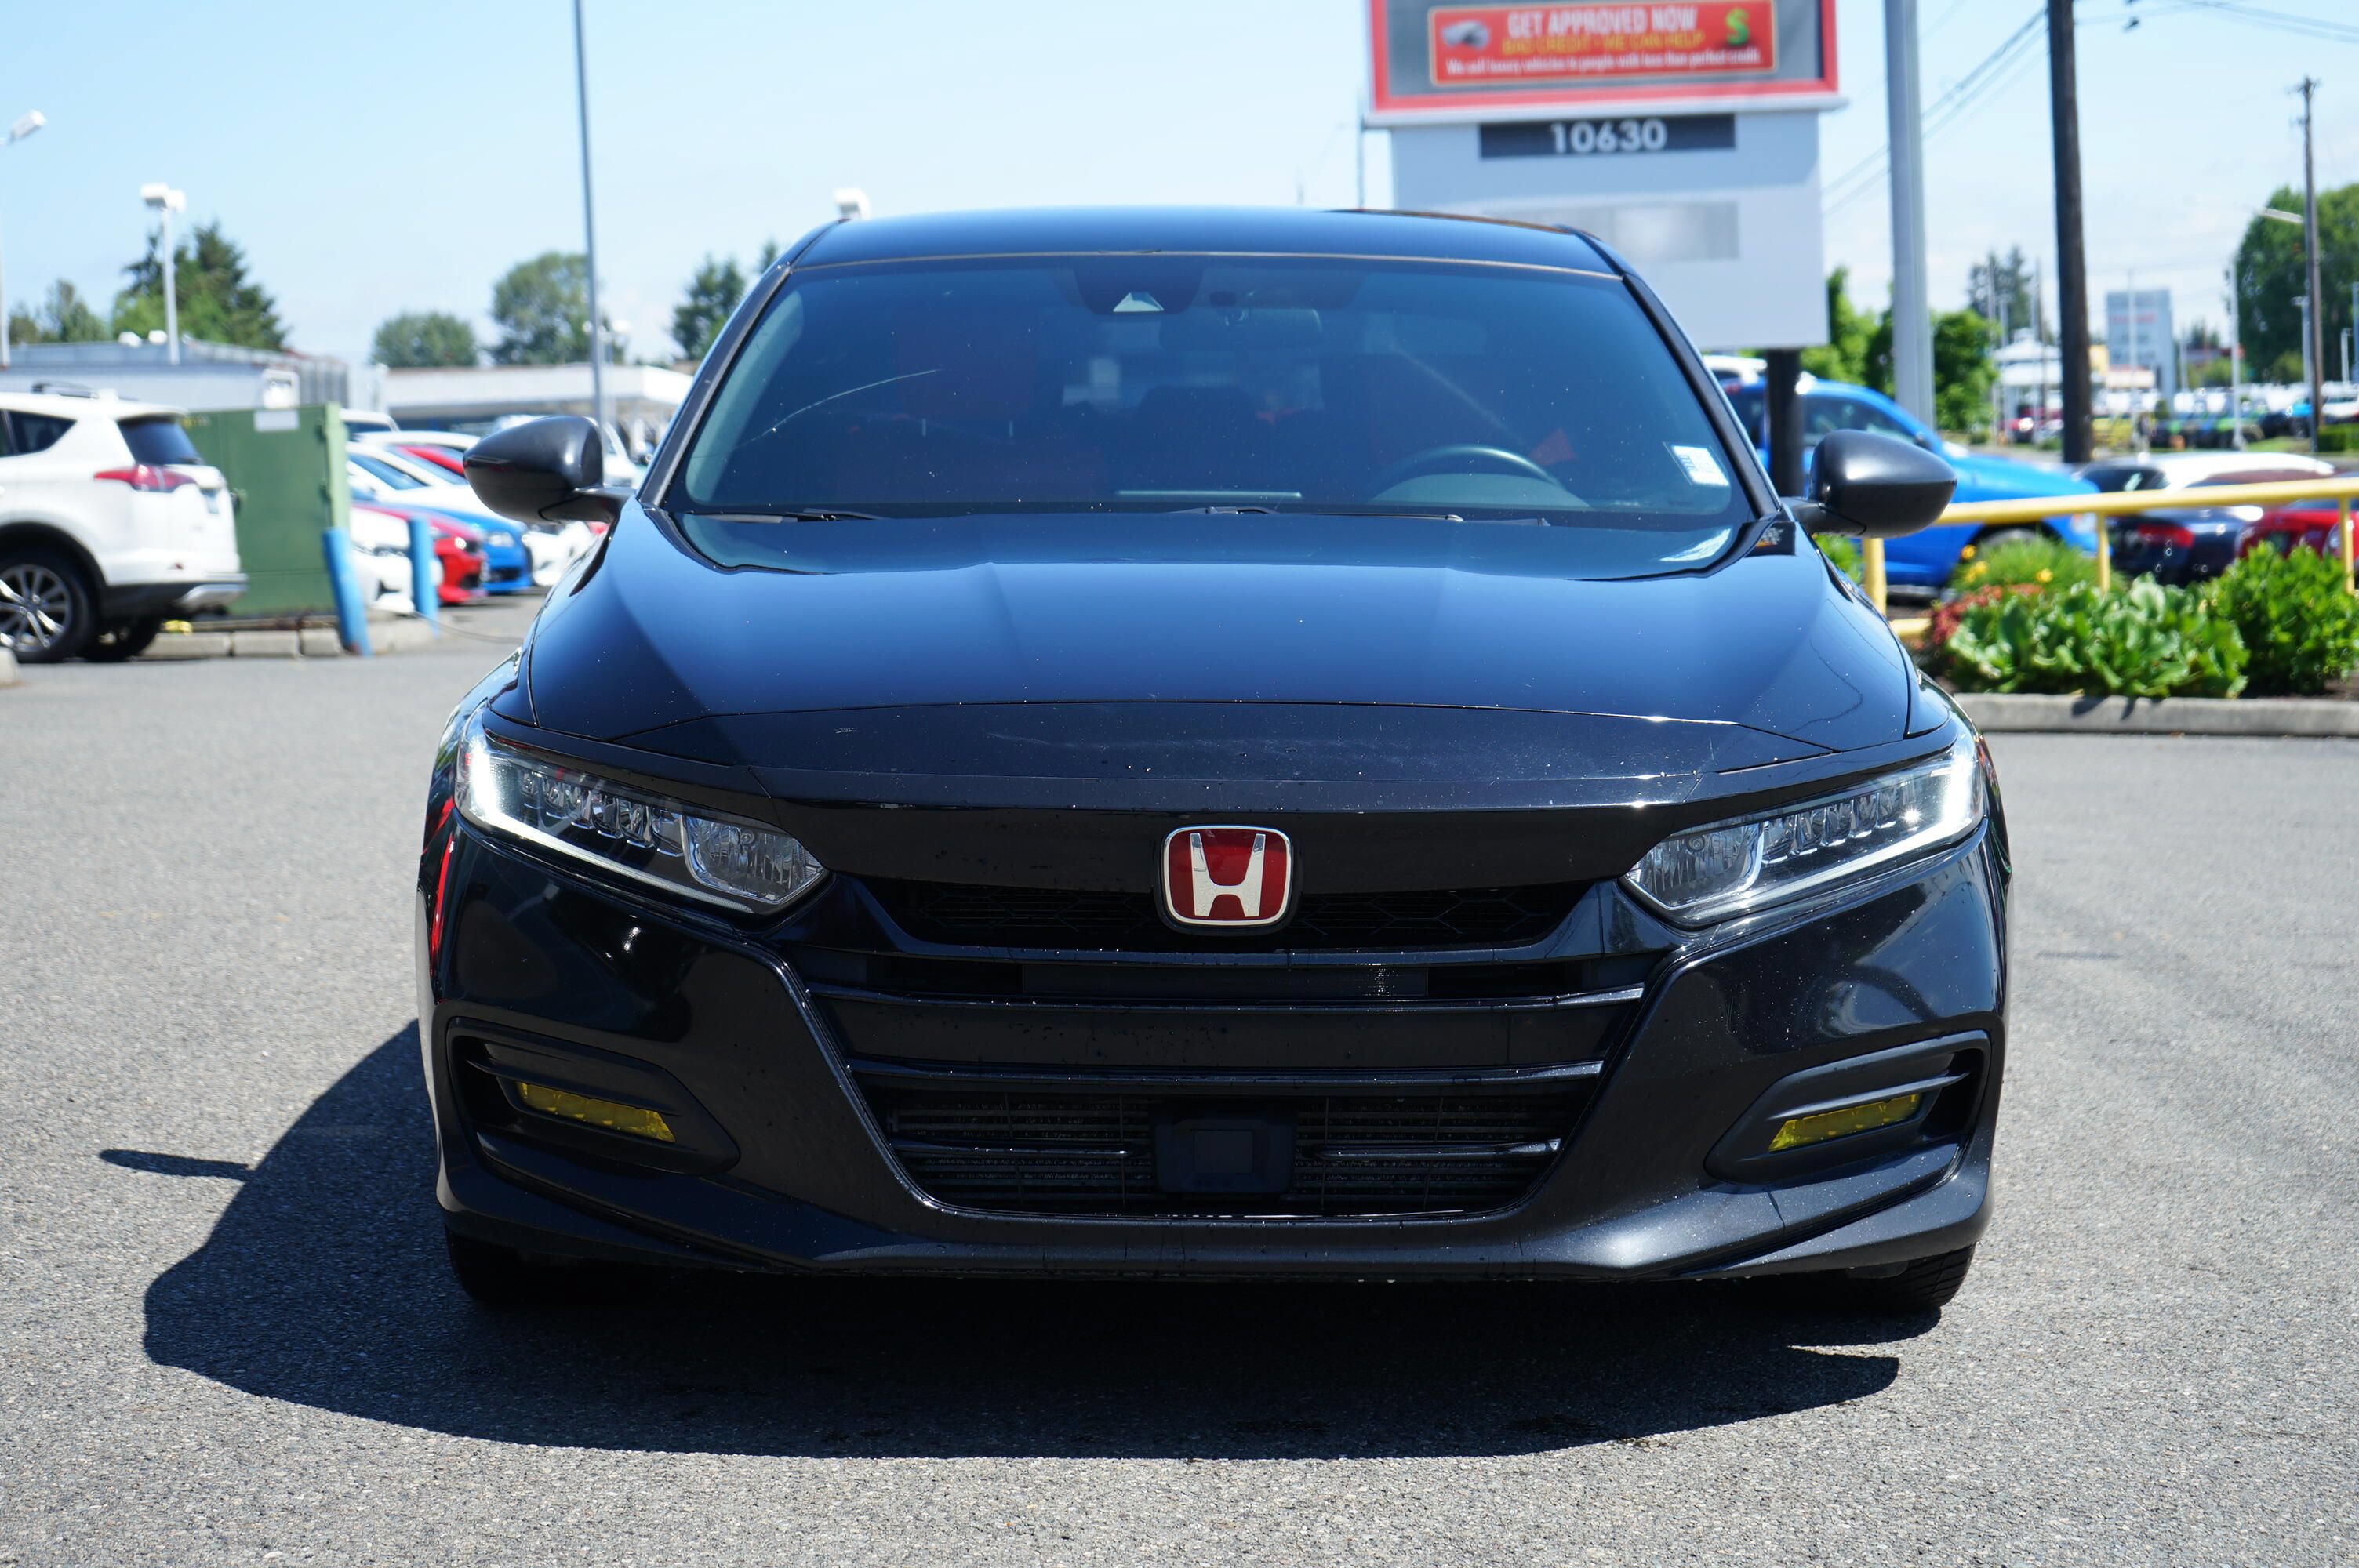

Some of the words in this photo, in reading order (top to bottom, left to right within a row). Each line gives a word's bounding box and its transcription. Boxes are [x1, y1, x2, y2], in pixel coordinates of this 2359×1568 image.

[1507, 11, 1543, 38] GET
[1547, 8, 1647, 36] APPROVED
[1651, 6, 1698, 33] NOW
[1630, 32, 1663, 50] CAN
[1665, 30, 1705, 49] HELP
[1580, 54, 1615, 74] people
[1618, 53, 1639, 69] with
[1642, 52, 1663, 67] less
[1666, 50, 1687, 67] than
[1689, 49, 1725, 69] perfect
[1550, 118, 1668, 154] 10630
